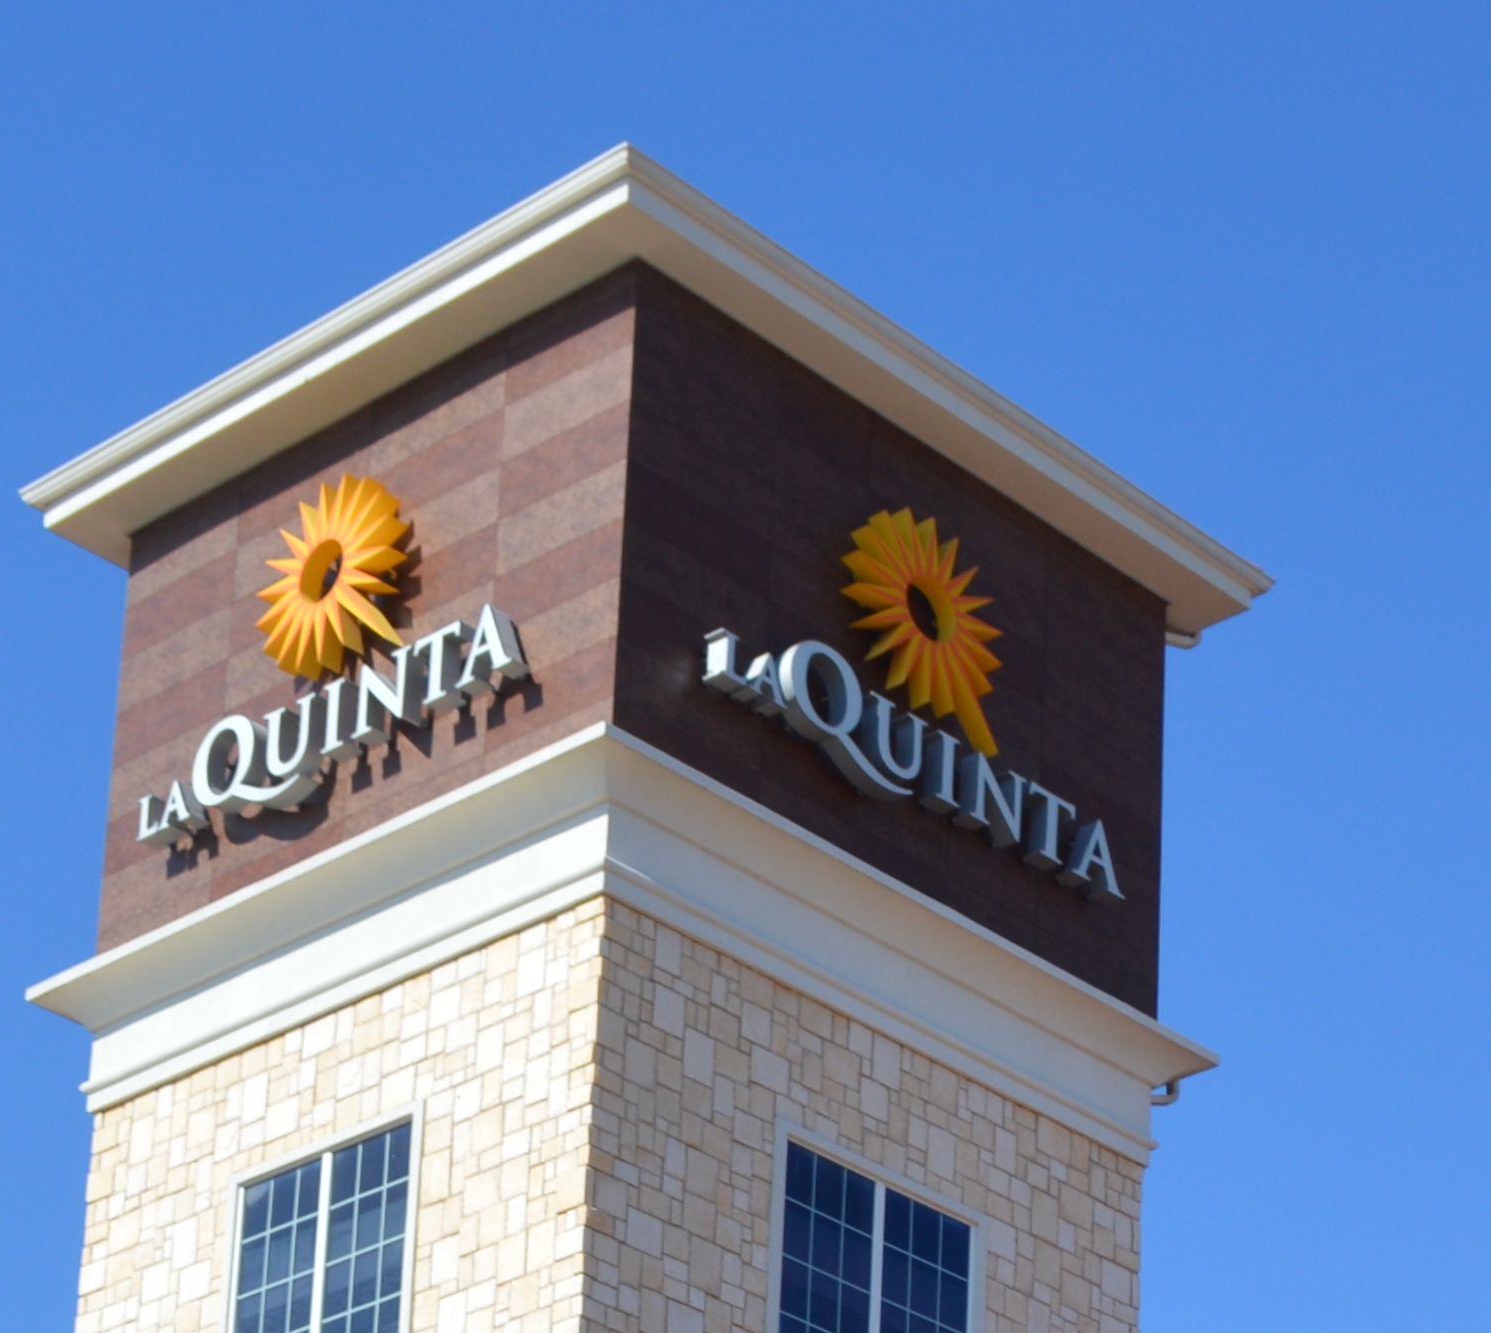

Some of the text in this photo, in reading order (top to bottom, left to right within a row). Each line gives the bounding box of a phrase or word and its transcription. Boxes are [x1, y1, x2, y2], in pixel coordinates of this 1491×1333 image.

[136, 603, 511, 842] LA QUINTA
[778, 639, 1126, 900] QUINTA
